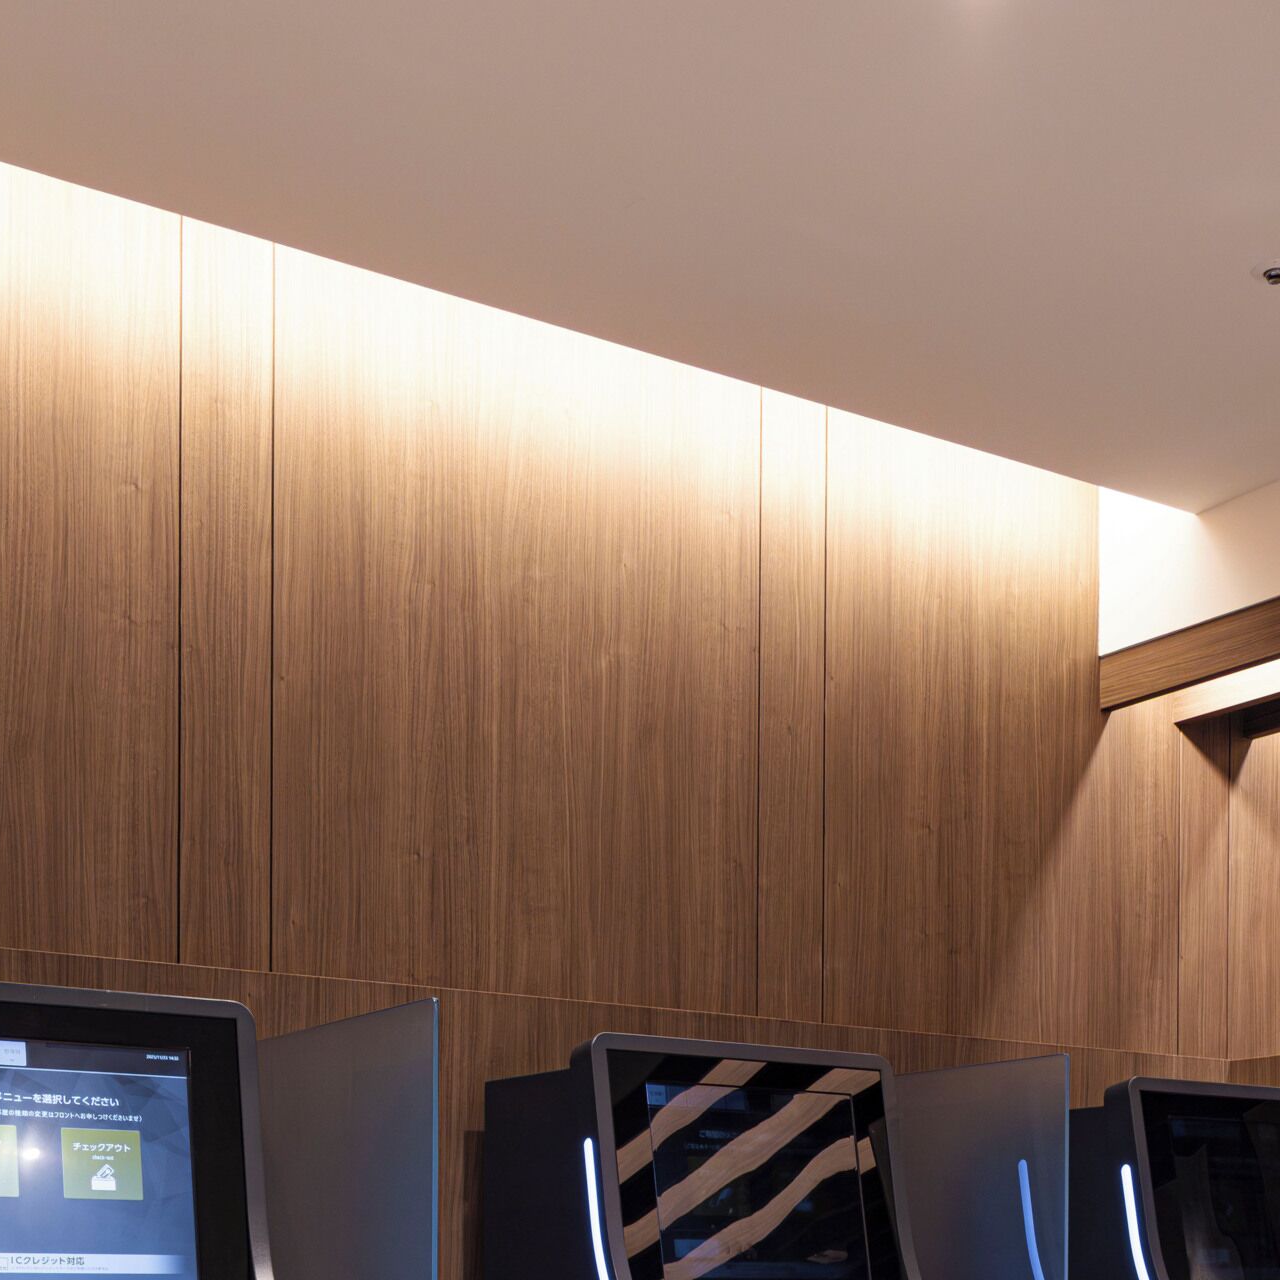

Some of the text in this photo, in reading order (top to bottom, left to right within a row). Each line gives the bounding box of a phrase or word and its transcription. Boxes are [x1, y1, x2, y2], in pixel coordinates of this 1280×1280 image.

[72, 1142, 131, 1153] チェックアウト
